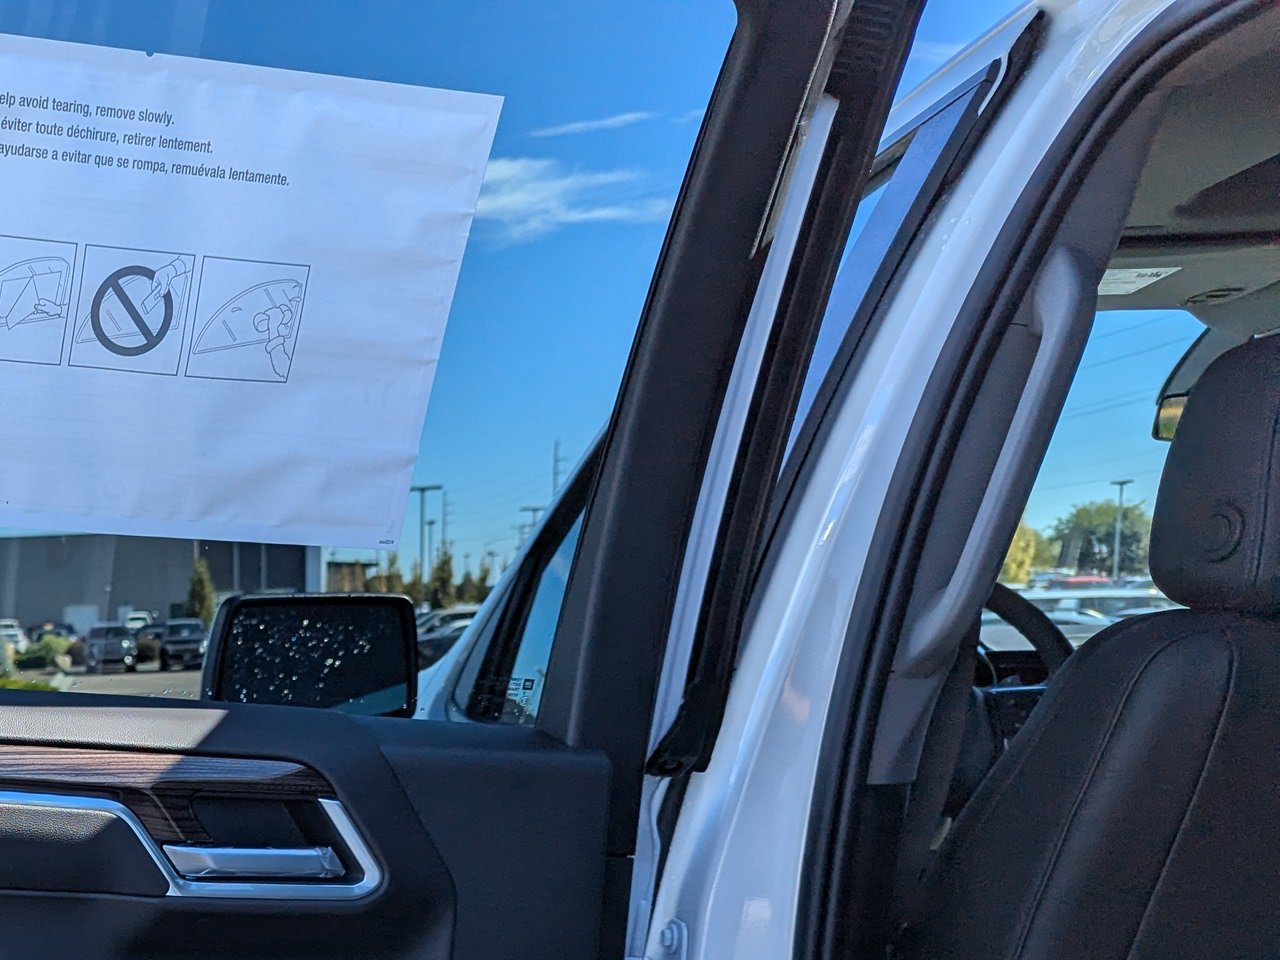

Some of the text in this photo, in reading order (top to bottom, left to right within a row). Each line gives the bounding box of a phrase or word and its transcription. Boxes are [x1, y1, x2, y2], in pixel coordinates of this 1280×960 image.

[18, 95, 49, 110] avoid
[52, 98, 92, 118] tearing,
[95, 105, 136, 120] remove
[138, 108, 175, 127] slowly.
[0, 116, 33, 133] éviter
[35, 120, 64, 137] toute
[66, 124, 119, 145] déchirure,
[122, 132, 157, 147] retirer
[158, 135, 213, 154] lentement.
[51, 150, 58, 160] a
[61, 149, 92, 164] evitar
[94, 154, 114, 168] que
[116, 157, 129, 168] se
[132, 159, 168, 175] rompa,
[171, 162, 226, 179] remuévala
[228, 167, 289, 186] lentamente.
